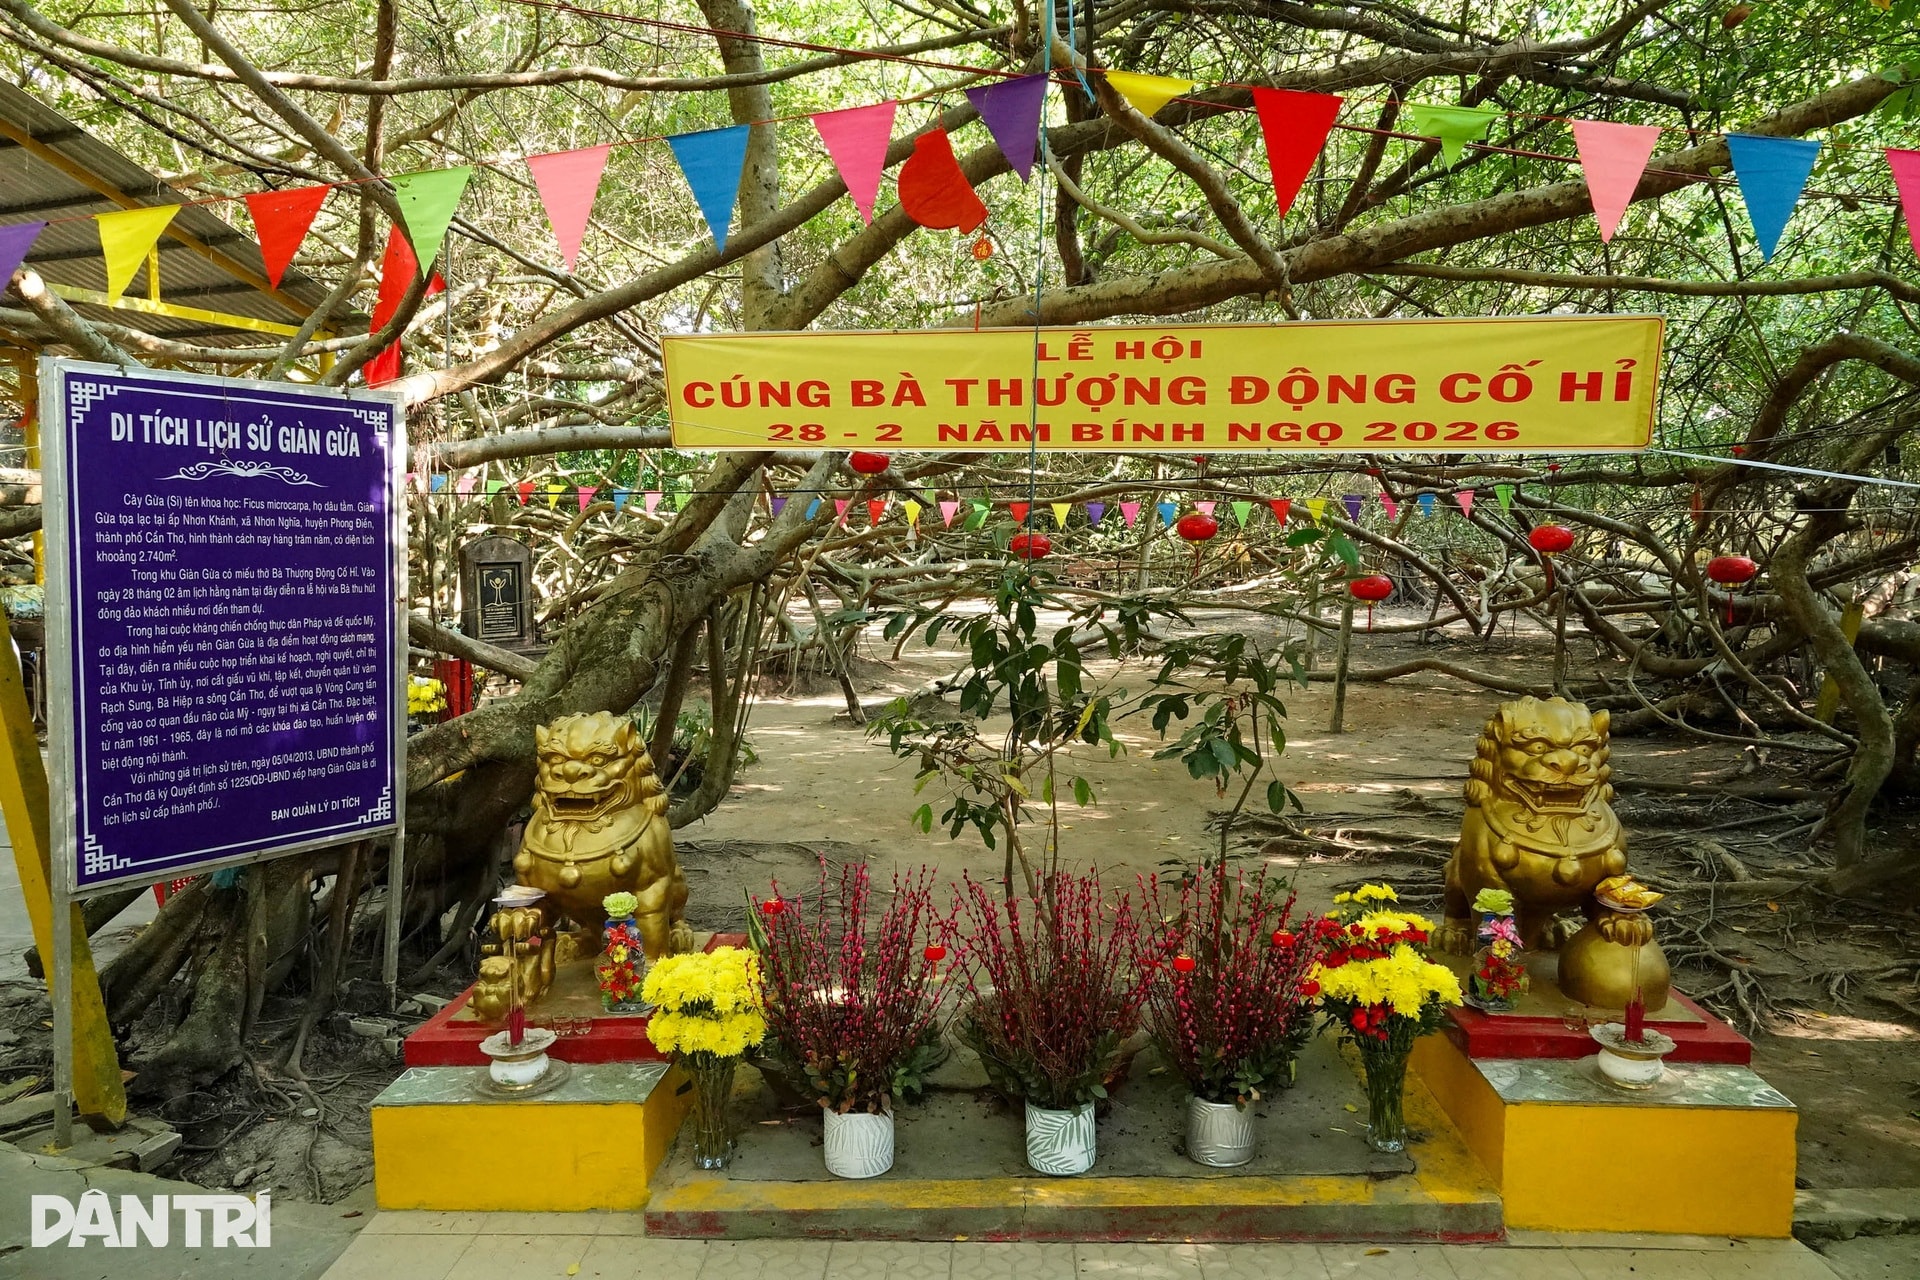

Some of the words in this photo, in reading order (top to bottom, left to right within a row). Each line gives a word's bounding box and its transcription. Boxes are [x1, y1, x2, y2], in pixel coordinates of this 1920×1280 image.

[1037, 332, 1093, 361] LỄ
[1115, 336, 1202, 364] HỘI
[683, 373, 831, 409] CÚNG
[850, 372, 927, 407] BÀ
[944, 372, 1207, 414] THƯỢNG
[1228, 367, 1416, 412] ĐỘNG
[1439, 359, 1543, 404] CỐ
[1559, 358, 1637, 402] HỈ
[110, 412, 133, 442] DI
[139, 408, 188, 446] TÍCH
[195, 419, 240, 455] LỊCH
[247, 414, 273, 451] SỬ
[278, 420, 320, 455] GIÀN
[325, 423, 360, 457] GỪA
[767, 423, 827, 442] 28
[876, 424, 901, 442] 2
[938, 420, 1049, 443] NĂM
[1071, 419, 1205, 443] BÍNH
[1228, 422, 1344, 446] NGỌ
[1364, 421, 1519, 442] 2026
[123, 493, 142, 508] Cây
[144, 494, 164, 506] Gừa
[184, 496, 199, 507] tên
[201, 496, 221, 508] khoa
[223, 497, 241, 509] học:
[243, 497, 265, 509] Ficus
[266, 501, 311, 512] microcarpa,
[312, 501, 322, 512] họ
[324, 501, 338, 511] dâu
[357, 501, 375, 512] Giàn
[95, 511, 115, 524] Gừa
[118, 513, 134, 525] tọa
[137, 513, 151, 526] lạc
[153, 513, 165, 526] tại
[168, 512, 180, 527] ấp
[183, 514, 206, 525] Nhơn
[208, 514, 238, 526] Khánh,
[241, 515, 251, 526] xã
[254, 515, 275, 526] Nhơn
[305, 517, 328, 530] huyện
[330, 517, 353, 531] Phong
[95, 531, 122, 543] thành
[125, 530, 142, 545] phố
[166, 532, 186, 544] Thơ,
[189, 532, 207, 543] hình
[209, 532, 233, 544] thành
[235, 533, 255, 544] cách
[257, 535, 271, 546] nay
[273, 533, 293, 547] hàng
[294, 534, 312, 544] trăm
[314, 534, 332, 545] năm,
[334, 534, 343, 544] có
[344, 534, 360, 545] diện
[362, 535, 374, 544] tích
[96, 549, 136, 565] khooảng
[131, 569, 157, 583] Trong
[160, 569, 176, 580] khu
[178, 568, 199, 580] Giàn
[202, 568, 220, 579] Gừa
[222, 568, 232, 579] có
[235, 566, 254, 579] miếu
[257, 567, 269, 578] thờ
[272, 567, 283, 578] Bà
[285, 567, 313, 580] Thượng
[315, 567, 335, 580] Động
[336, 566, 347, 577] Cố
[361, 567, 375, 577] Vào
[97, 588, 120, 603] ngày
[122, 588, 134, 599] 28
[136, 587, 162, 601] tháng
[163, 587, 175, 598] 02
[177, 587, 190, 598] âm
[193, 587, 207, 599] lịch
[232, 586, 249, 596] năm
[251, 586, 261, 597] tại
[263, 585, 277, 598] đây
[297, 586, 305, 595] ra
[315, 584, 327, 594] hội
[328, 584, 339, 594] vía
[340, 583, 350, 593] Bà
[351, 583, 363, 593] thu
[364, 583, 375, 593] hút
[97, 607, 121, 621] đông
[123, 605, 141, 618] đảo
[143, 606, 170, 617] khách
[198, 604, 210, 615] nơi
[212, 602, 228, 615] đến
[230, 603, 250, 614] tham
[252, 603, 264, 614] dự.
[101, 757, 119, 770] biệt
[121, 755, 144, 768] động
[146, 752, 159, 765] nội
[161, 749, 188, 762] thành.
[130, 772, 145, 784] Với
[148, 770, 175, 782] những
[177, 766, 190, 781] giá
[192, 765, 201, 777] trị
[203, 763, 217, 776] lịch
[219, 760, 229, 773] sử
[231, 759, 249, 770] trên,
[251, 758, 270, 770] ngày
[271, 750, 315, 765] 05/04/2013,
[316, 747, 338, 759] UBND
[340, 745, 359, 755] thành
[361, 742, 374, 755] phố
[124, 792, 142, 803] Thơ
[144, 789, 155, 801] đã
[158, 787, 168, 801] ký
[170, 782, 196, 798] Quyết
[198, 781, 215, 793] định
[218, 779, 227, 790] số
[230, 770, 290, 788] 1225/QĐ-UBND
[292, 768, 306, 780] xếp
[307, 767, 325, 777] hạng
[327, 763, 344, 774] Giàn
[345, 760, 360, 771] Gừa
[369, 758, 376, 768] di
[103, 813, 119, 825] tích
[122, 810, 137, 824] lịch
[139, 807, 150, 820] sử
[153, 804, 169, 818] cấp
[171, 801, 195, 814] thành
[271, 808, 289, 821] BAN
[291, 801, 316, 817] QUẢN
[318, 799, 329, 813] LÝ
[331, 800, 339, 810] DI
[341, 796, 360, 808] TÍCH
